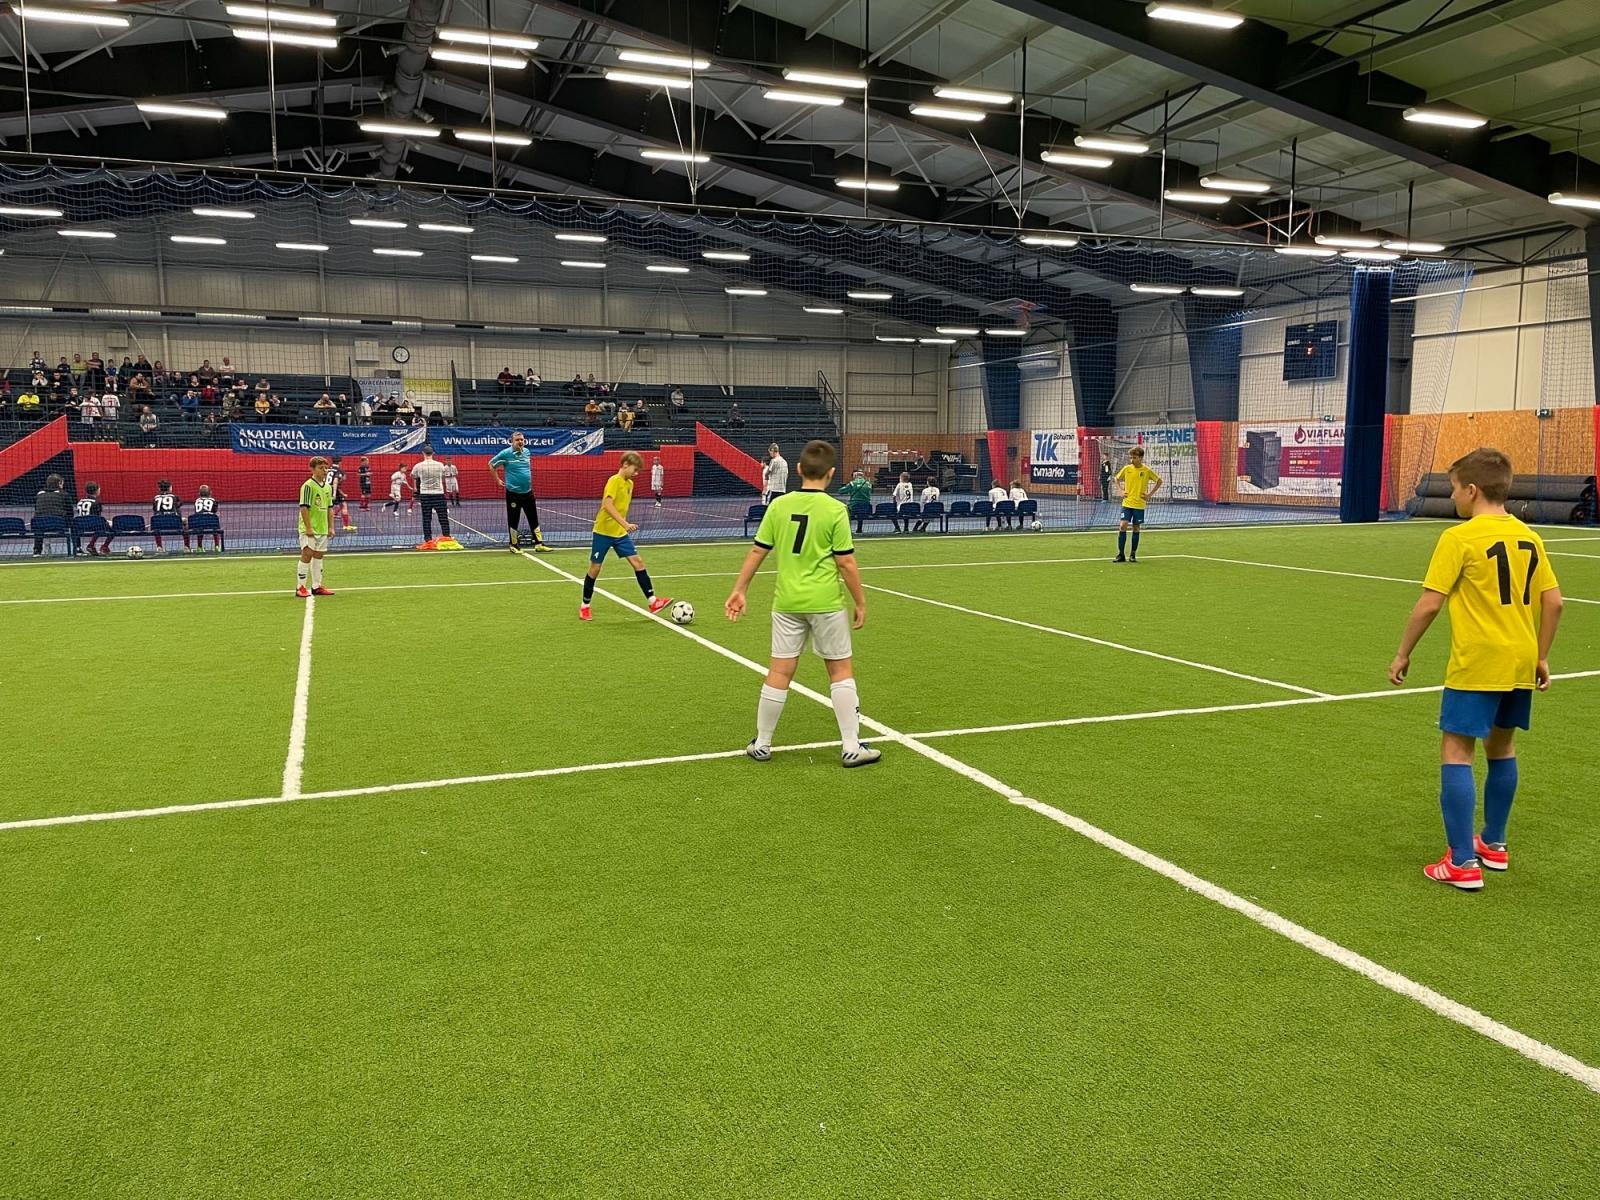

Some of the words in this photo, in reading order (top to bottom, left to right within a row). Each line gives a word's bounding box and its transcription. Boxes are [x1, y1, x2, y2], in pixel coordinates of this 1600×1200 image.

[239, 429, 305, 440] AKADEMIA
[443, 436, 555, 447] www.uniaracorz.eu
[1139, 428, 1197, 443] NTERNET
[269, 437, 336, 450] RACIBÓRZ
[790, 514, 809, 554] 7
[1485, 541, 1539, 606] 17
